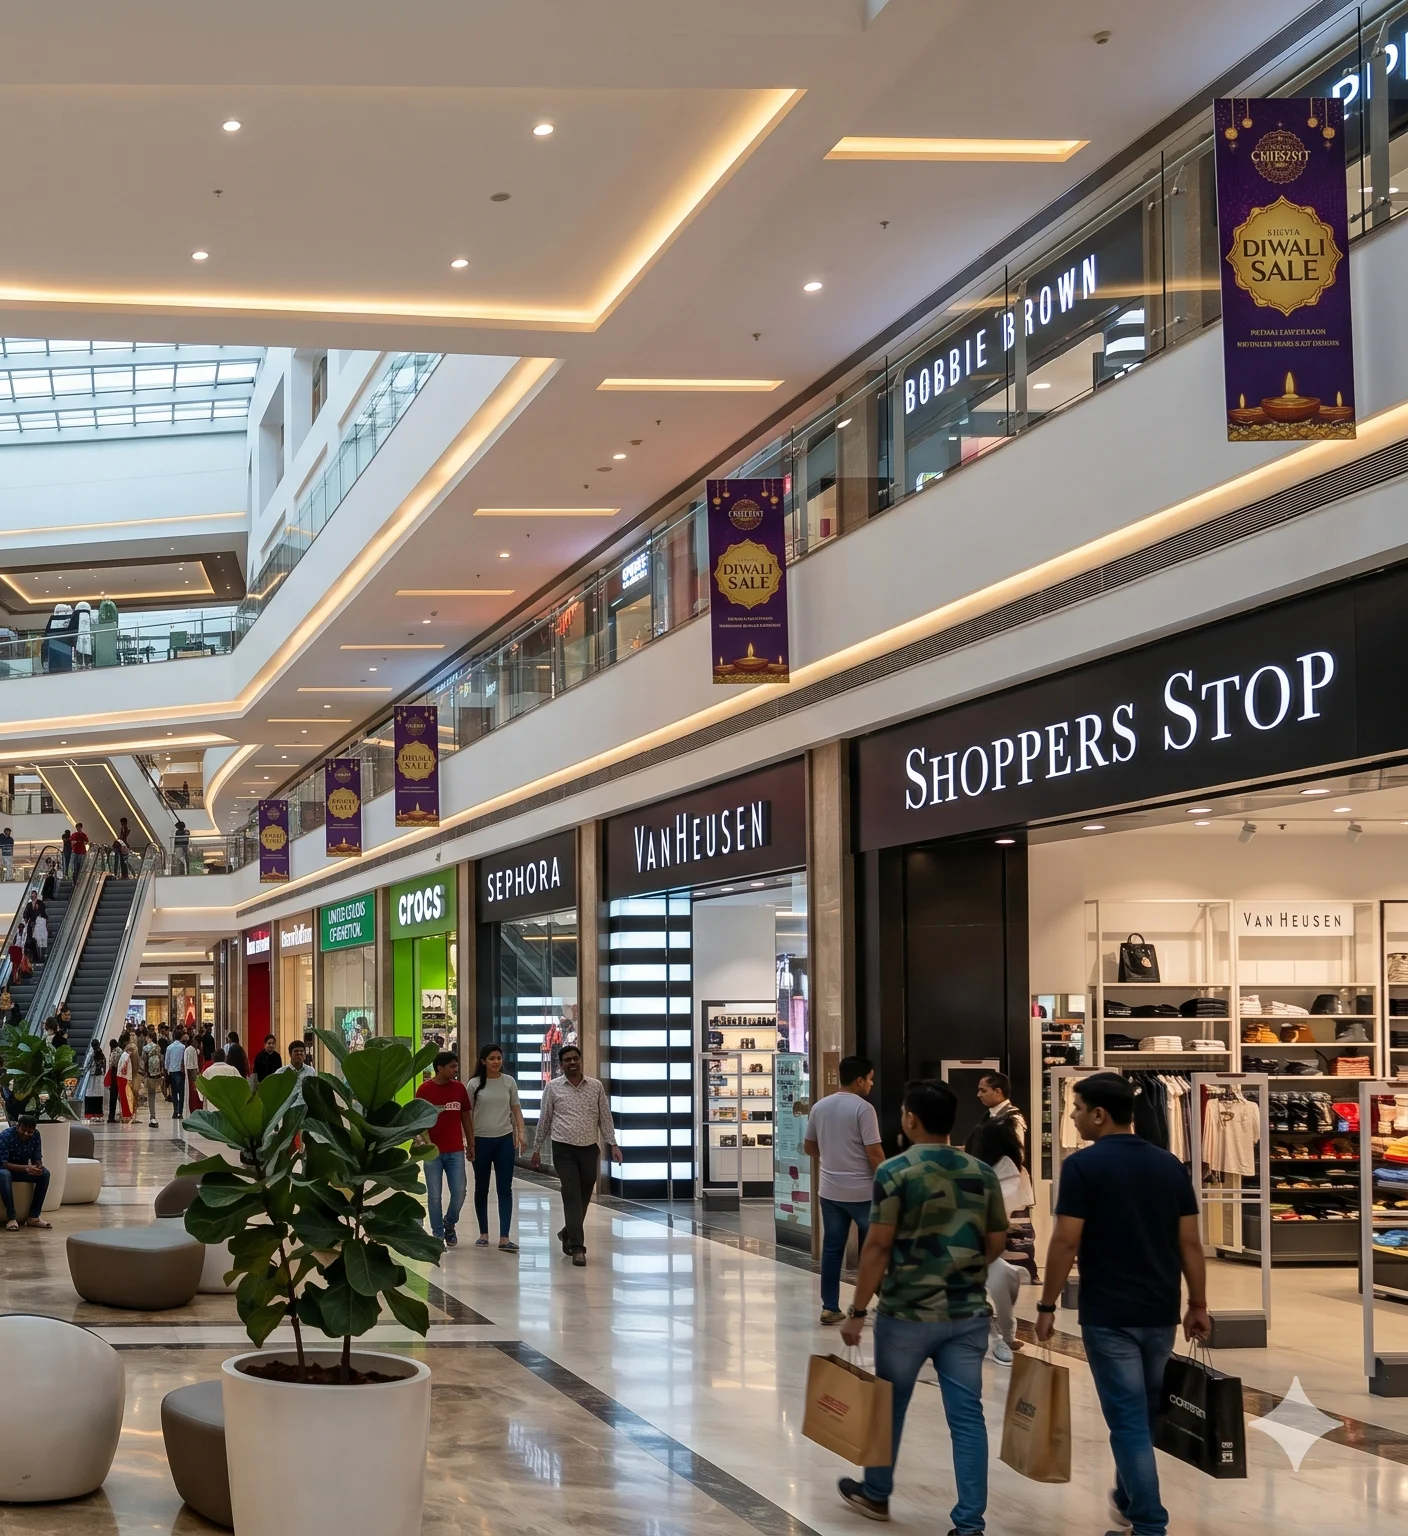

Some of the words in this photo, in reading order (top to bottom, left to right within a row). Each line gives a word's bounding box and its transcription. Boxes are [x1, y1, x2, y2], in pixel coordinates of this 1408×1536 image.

[1243, 238, 1326, 258] DIWALI
[1252, 260, 1320, 282] SALE
[905, 329, 987, 415] BOBBIE
[1003, 254, 1096, 352] BROWN
[723, 564, 773, 575] DIWALI
[728, 576, 770, 590] SALE
[904, 702, 1137, 810] SHOPPERS
[1163, 650, 1335, 751] STOP
[487, 856, 561, 903] SEPHORA
[398, 884, 442, 926] crocs
[1243, 912, 1273, 928] VAN
[1279, 912, 1342, 928] HEUSEN
